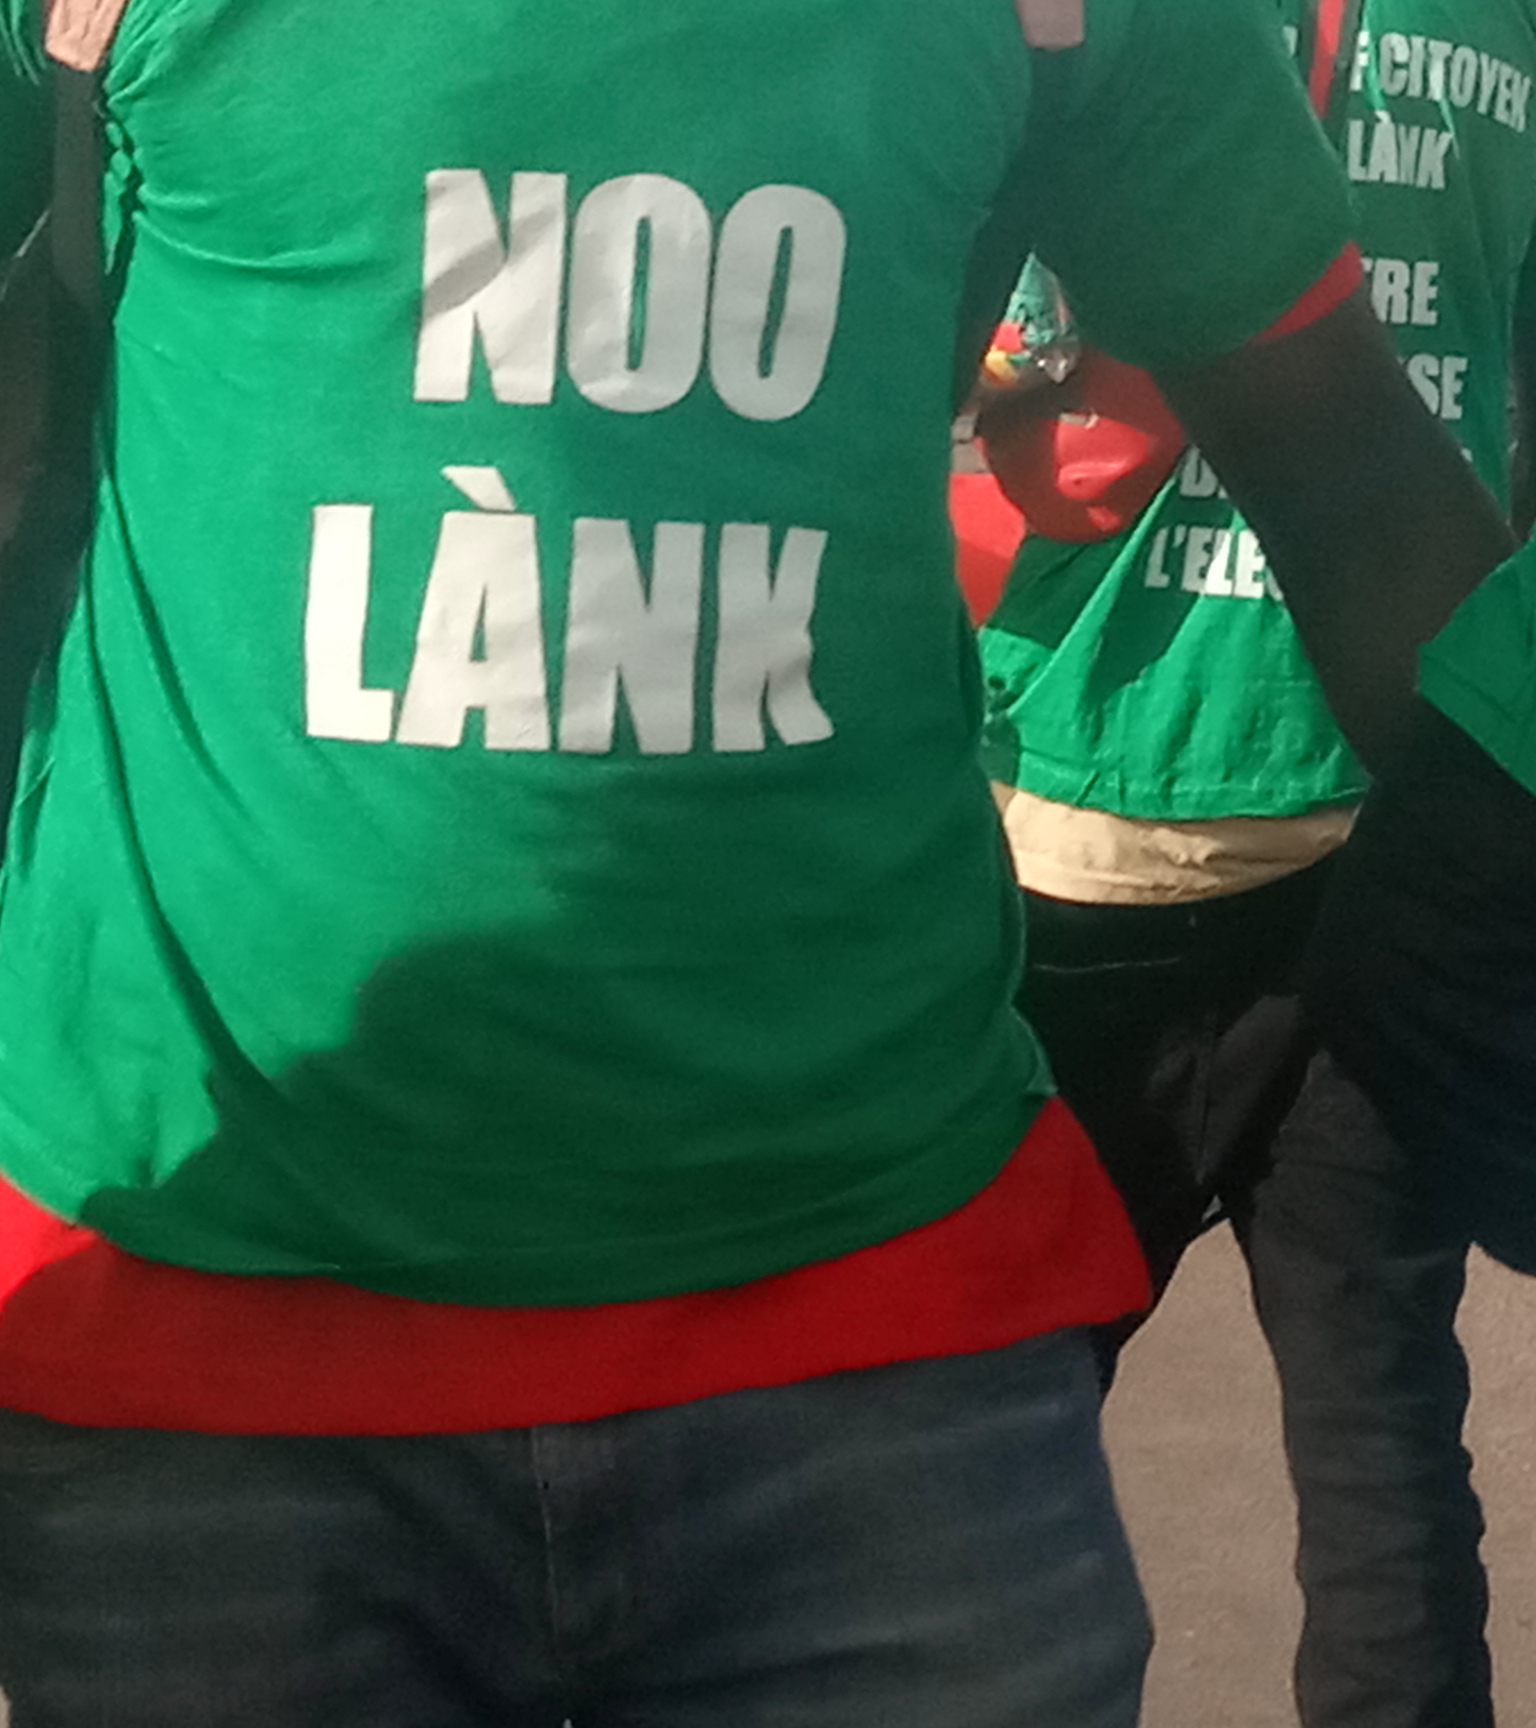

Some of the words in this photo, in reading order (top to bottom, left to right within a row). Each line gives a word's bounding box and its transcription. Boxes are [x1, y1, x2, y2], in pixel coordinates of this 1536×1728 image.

[1379, 31, 1532, 133] CITOYEN
[413, 167, 847, 422] NOO
[304, 464, 835, 755] LÀNK
[1144, 524, 1285, 601] L'ELE
